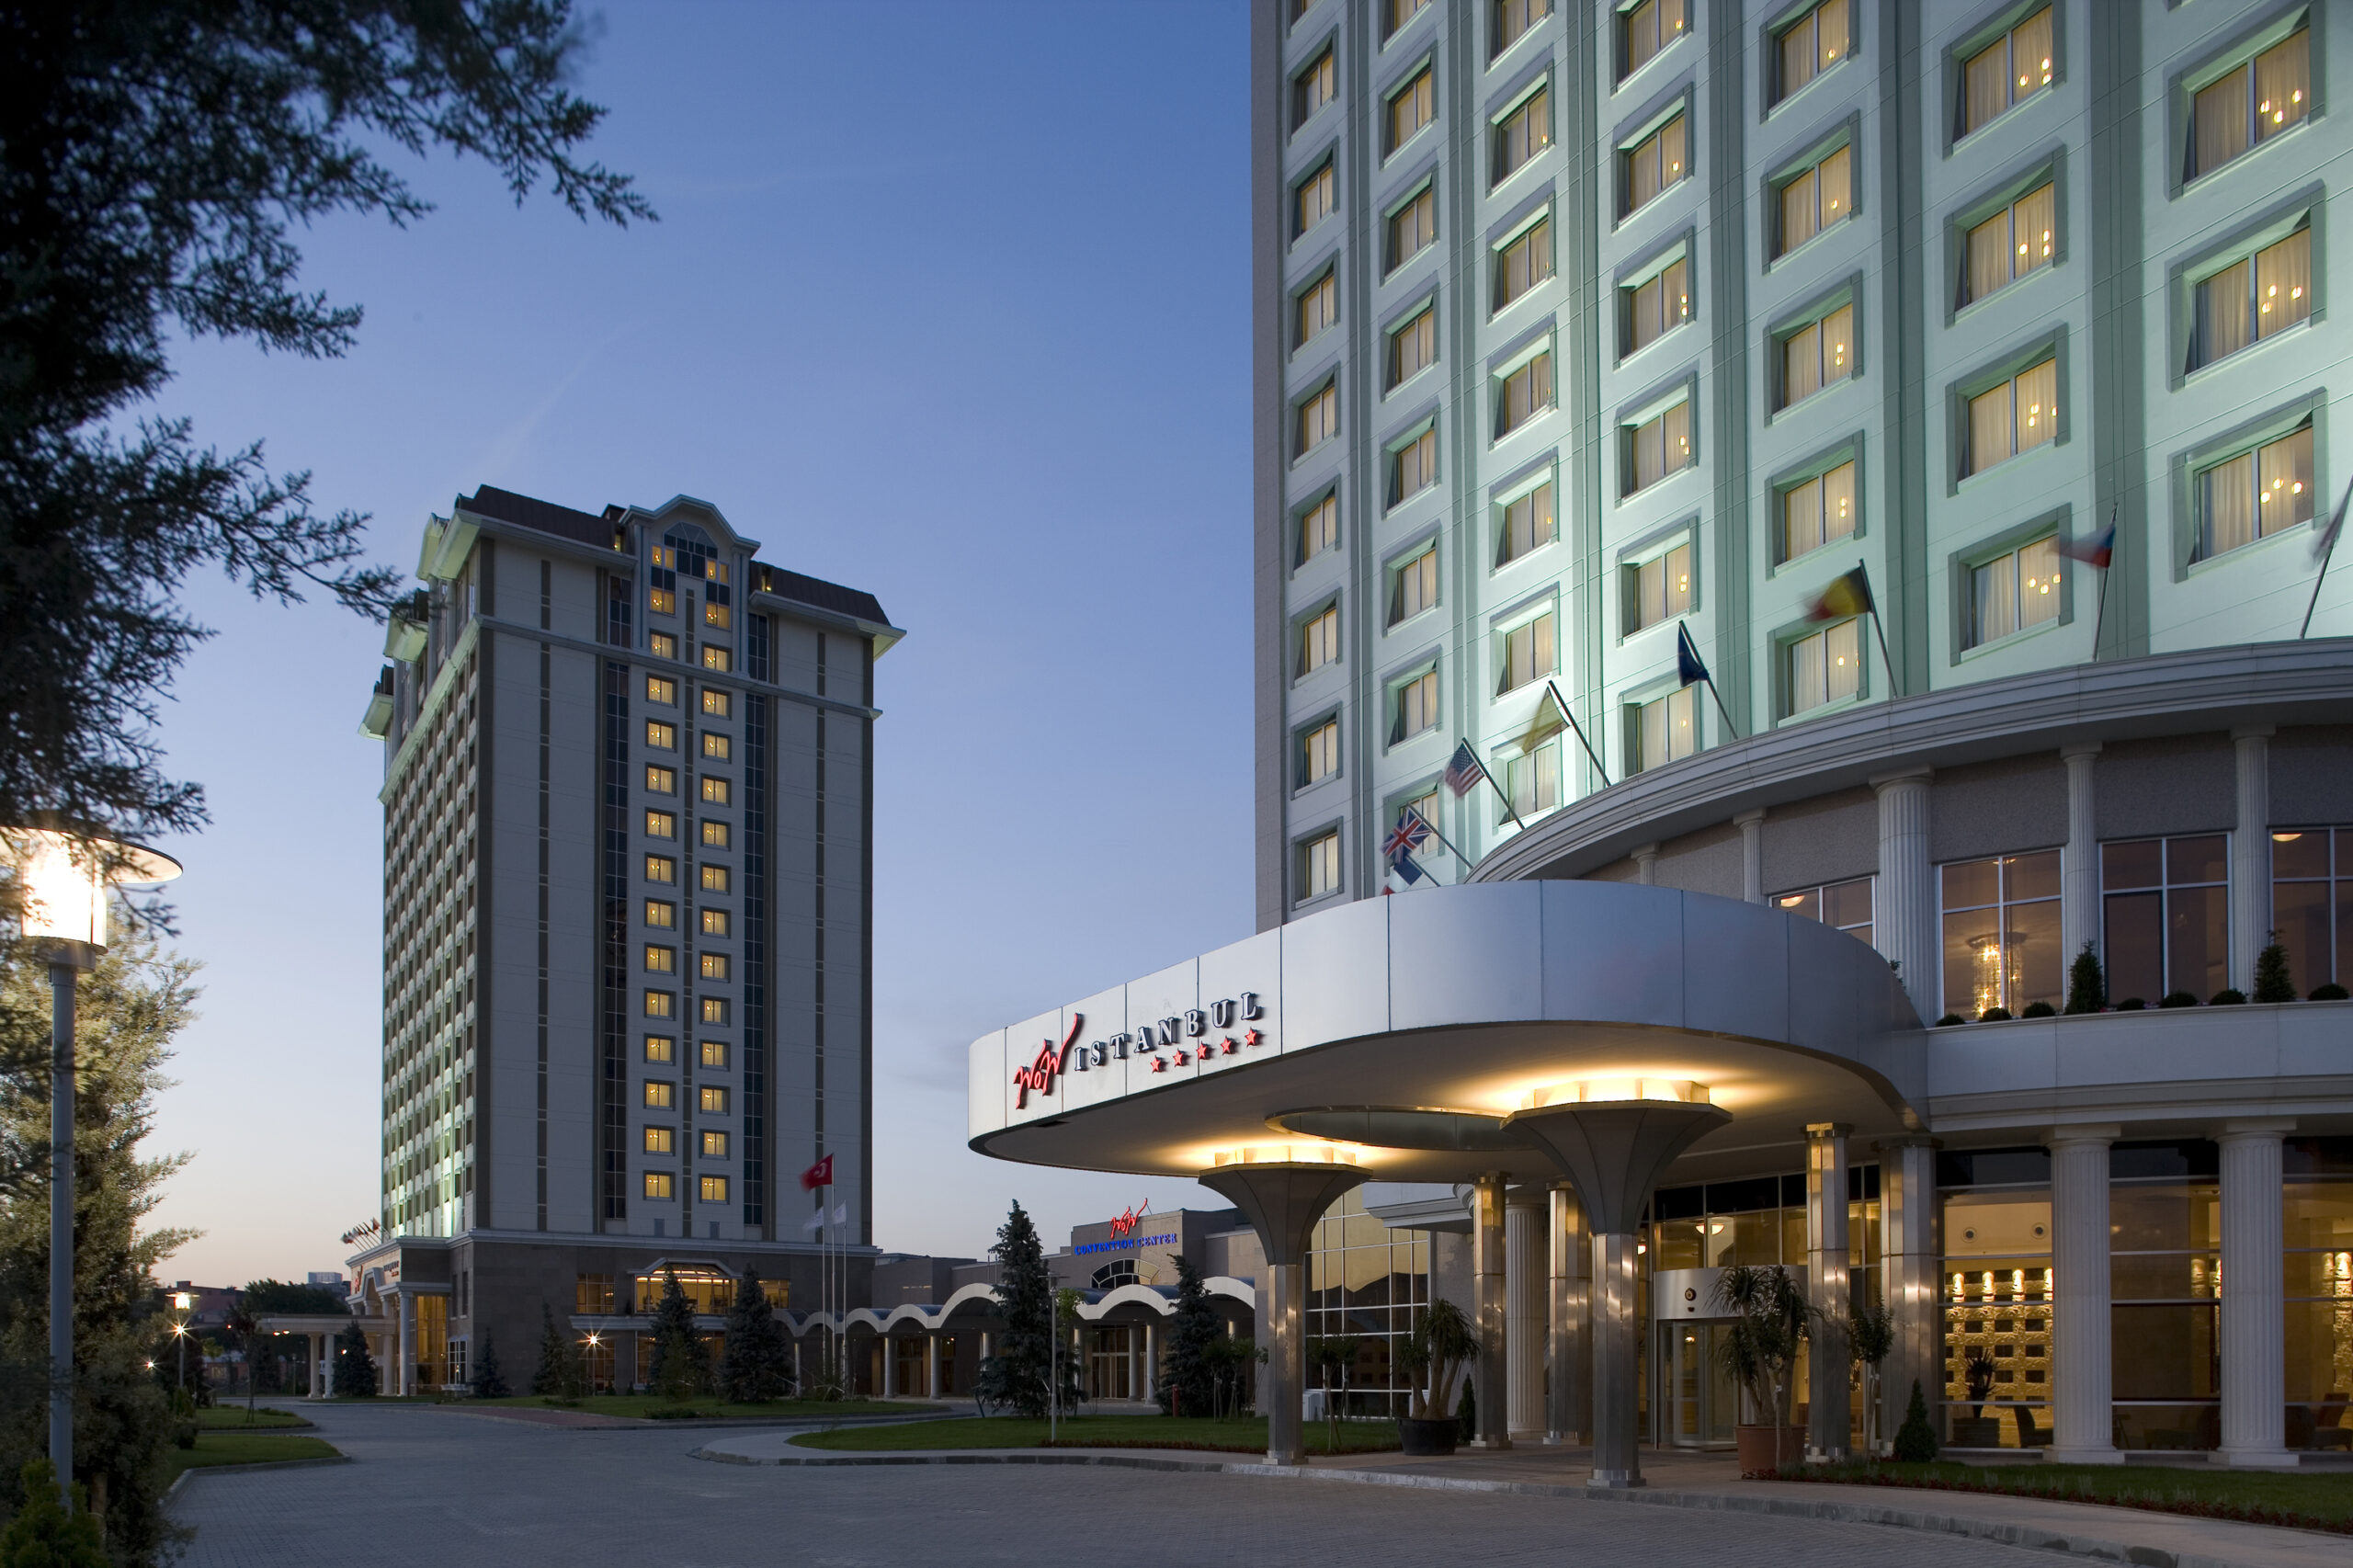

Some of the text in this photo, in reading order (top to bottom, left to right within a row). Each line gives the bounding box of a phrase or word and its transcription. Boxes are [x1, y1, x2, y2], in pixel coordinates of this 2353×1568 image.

[1074, 992, 1261, 1072] ISTANBUL
[1074, 1233, 1177, 1256] CONVENTION CENTER
